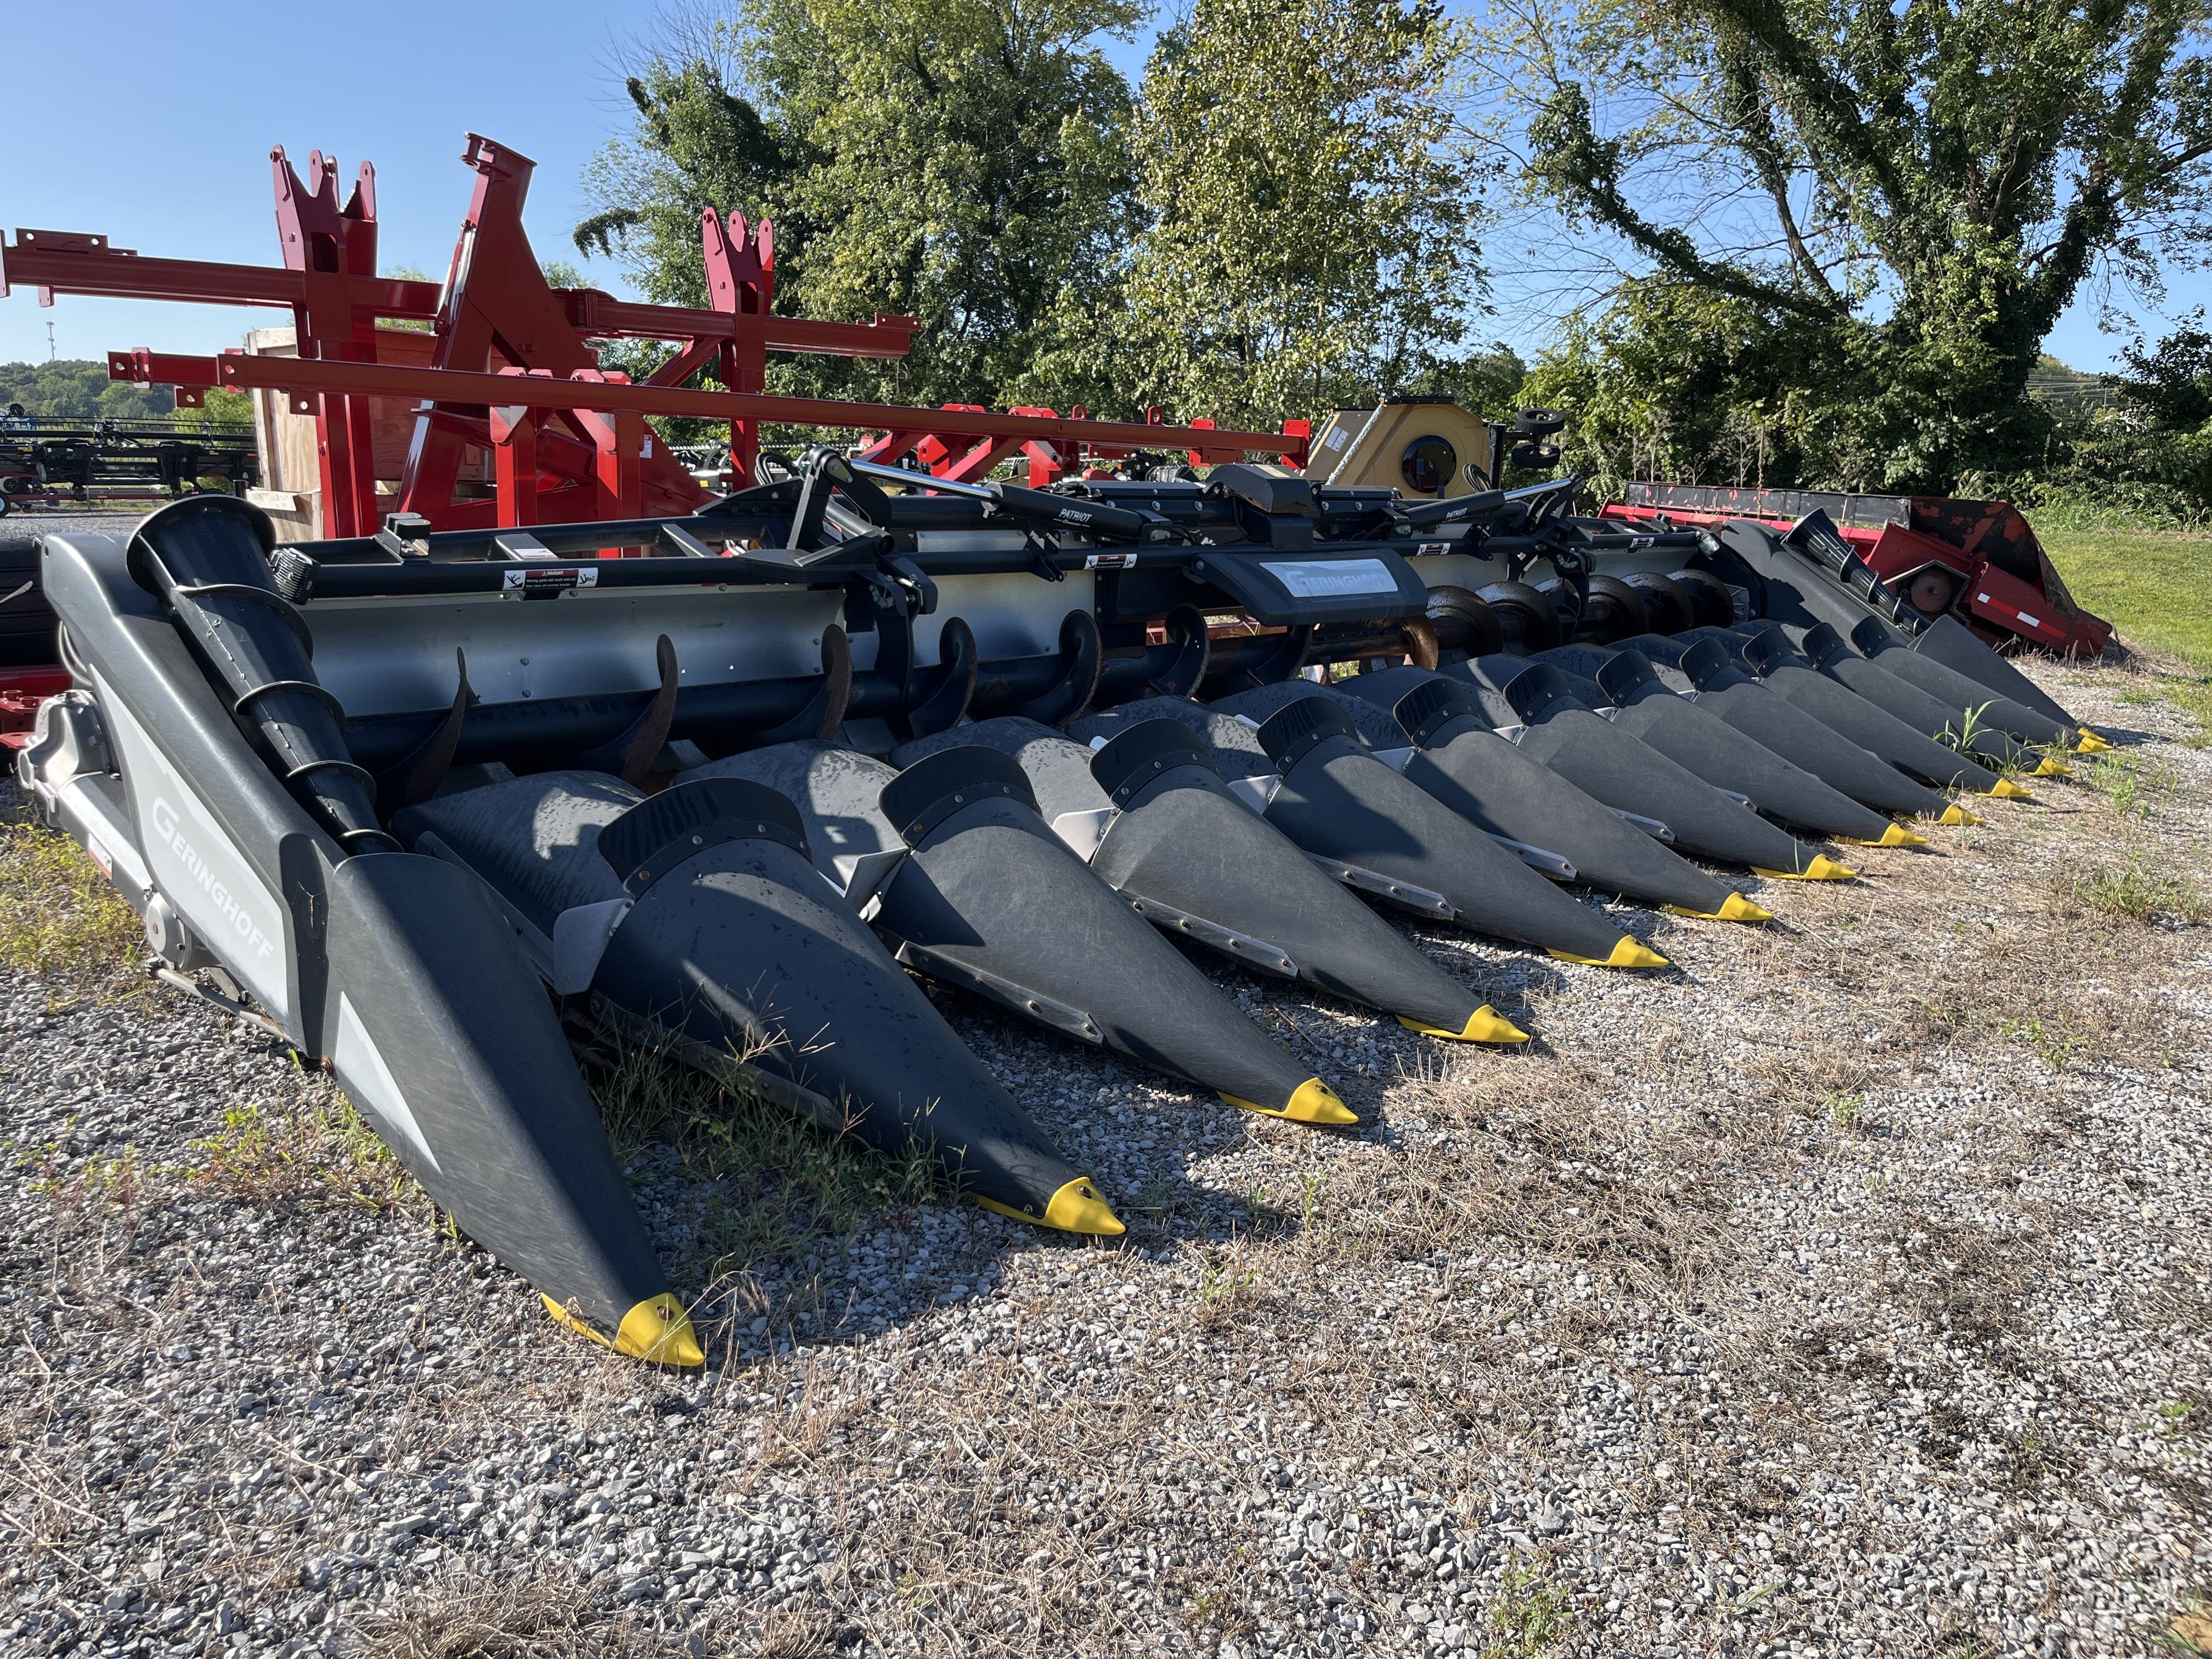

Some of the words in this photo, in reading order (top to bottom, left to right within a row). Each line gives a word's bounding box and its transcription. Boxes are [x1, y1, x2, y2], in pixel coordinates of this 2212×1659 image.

[1059, 508, 1092, 523] PATRIOT
[1445, 507, 1468, 520] PATRIOT
[153, 797, 274, 957] GERINGHOFF
